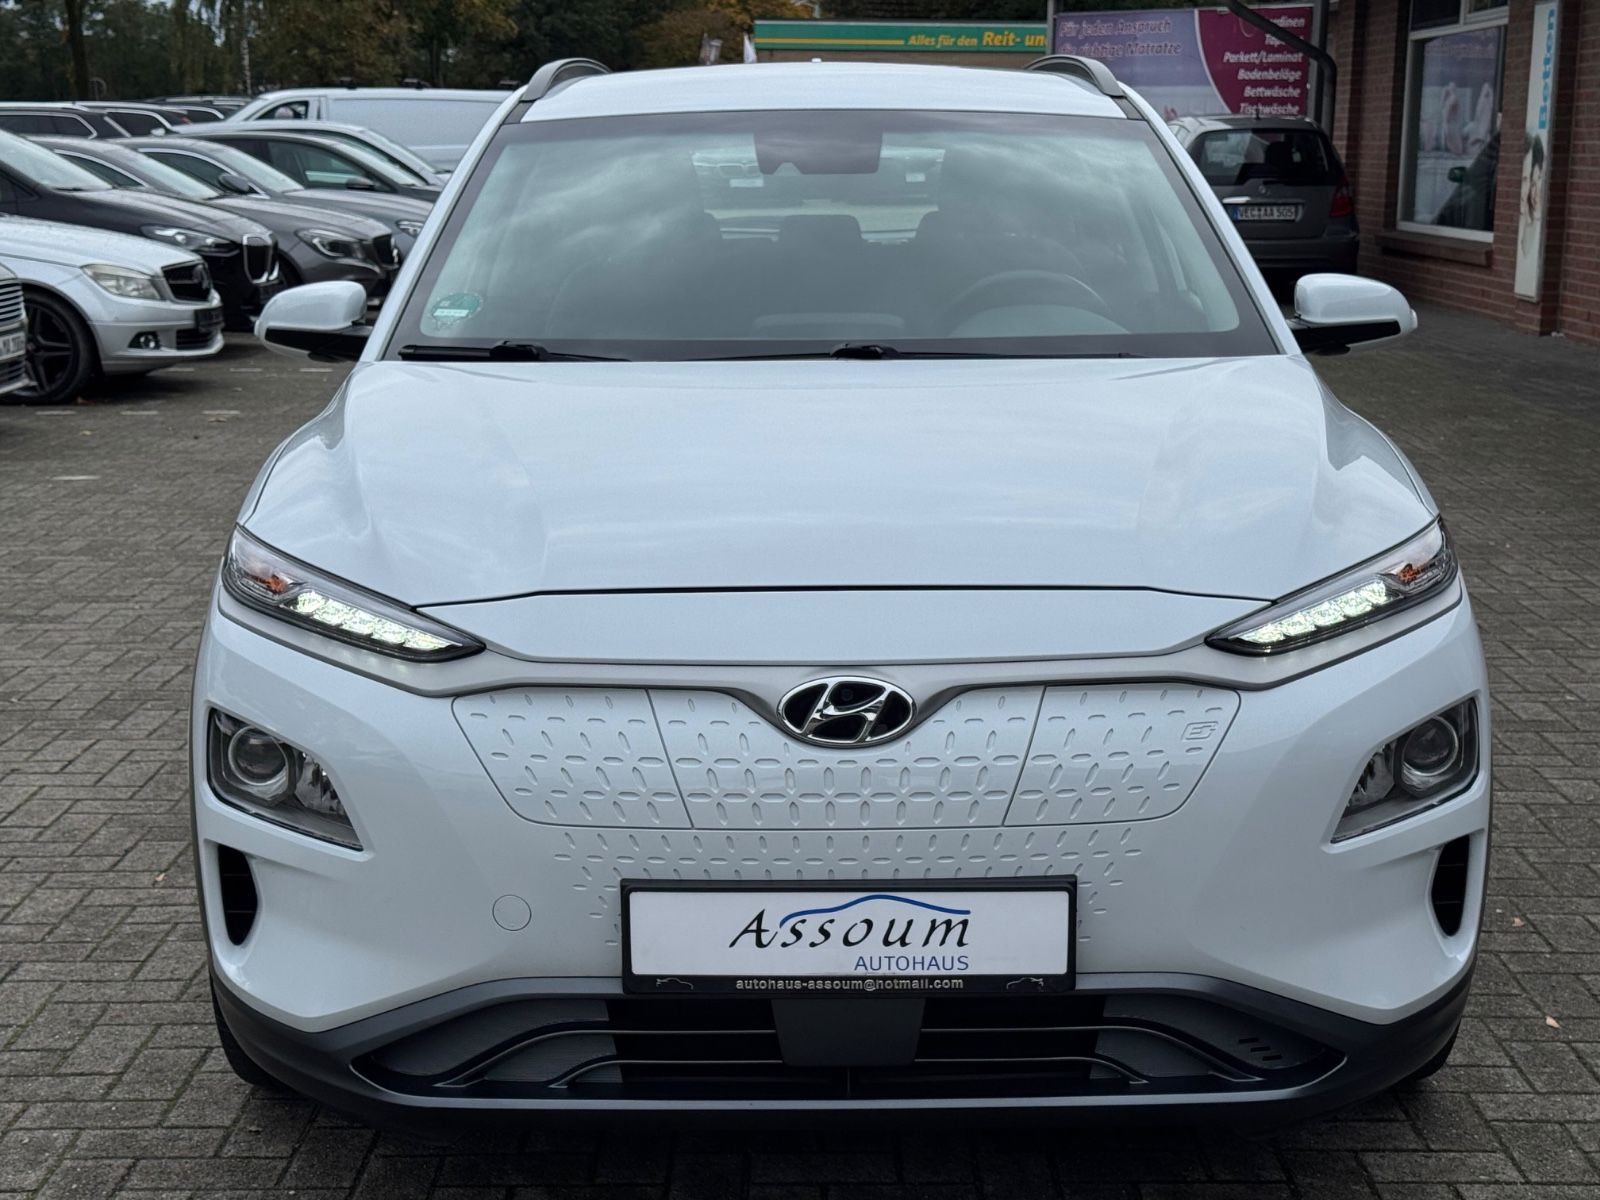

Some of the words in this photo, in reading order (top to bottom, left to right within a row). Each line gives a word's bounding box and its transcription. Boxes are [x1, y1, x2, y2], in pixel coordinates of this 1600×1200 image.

[1059, 21, 1079, 37] Für
[1078, 19, 1113, 40] jeden
[1115, 16, 1172, 37] Anspruch
[908, 35, 935, 46] Alles
[937, 35, 954, 49] für
[957, 35, 977, 46] den
[983, 31, 1020, 46] Reit-
[1024, 34, 1046, 46] un
[1125, 41, 1183, 57] Matratze
[1223, 50, 1303, 64] Parkett/Laminat
[1237, 67, 1302, 82] Bodenbeläge
[1243, 84, 1301, 98] Bettwäsche
[1239, 102, 1299, 115] Tischwäsche
[729, 908, 970, 949] Assoum
[854, 955, 969, 971] AUTOHAUS
[735, 978, 964, 992] autohaus-assoum@hotmail.com
